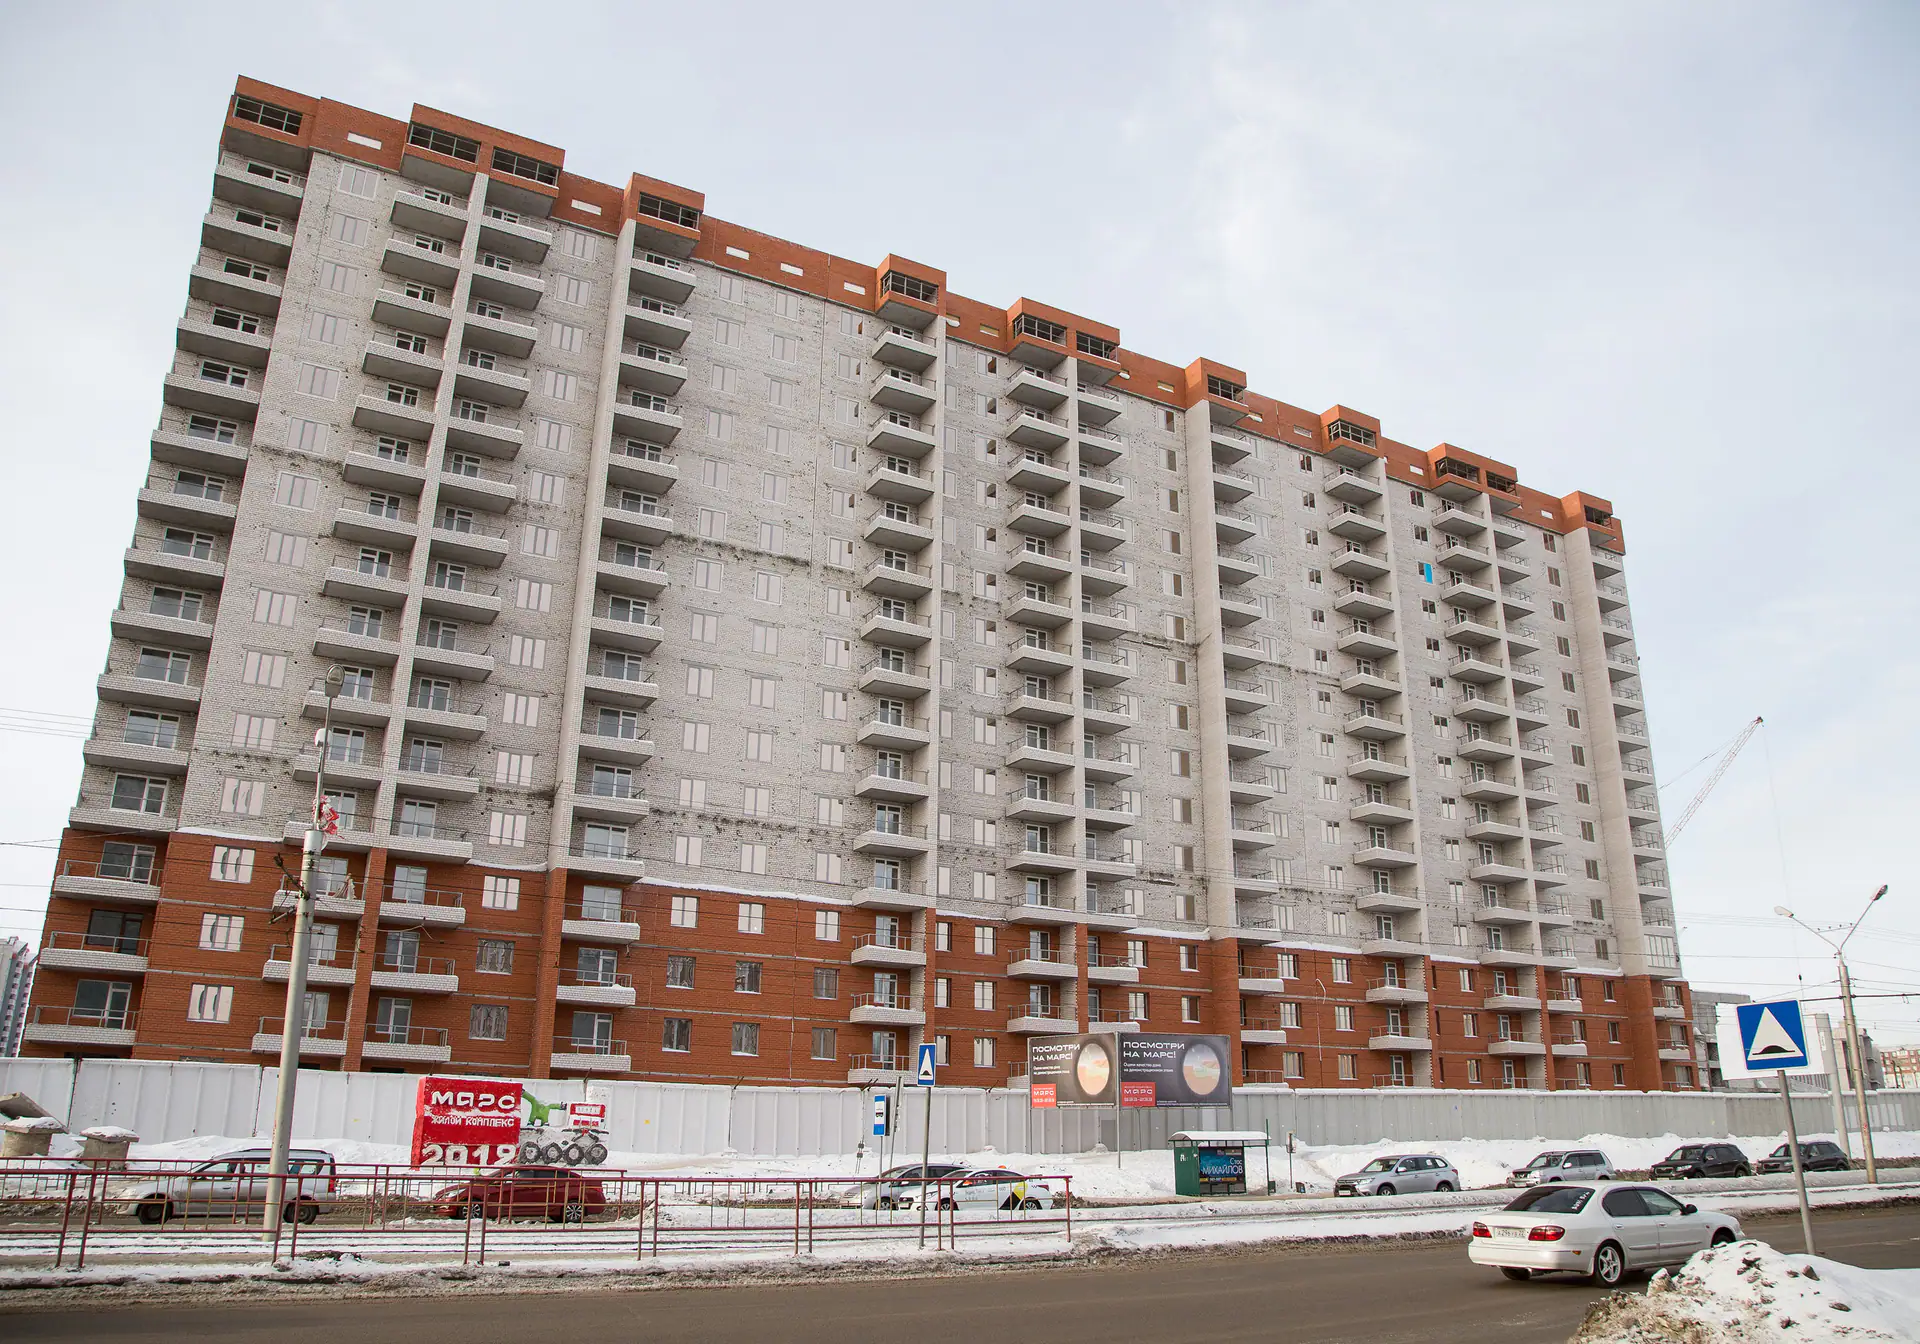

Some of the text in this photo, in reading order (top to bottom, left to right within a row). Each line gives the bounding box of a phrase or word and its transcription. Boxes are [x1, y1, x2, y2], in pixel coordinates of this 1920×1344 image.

[1032, 1043, 1080, 1053] ПОСМОТРИ
[1123, 1041, 1185, 1050] ПОСМОТРИ
[1046, 1052, 1073, 1061] МАРС!
[1143, 1051, 1176, 1059] МАРС!
[465, 1116, 515, 1128] КОМПЛЕКС
[420, 1144, 516, 1166] 2019
